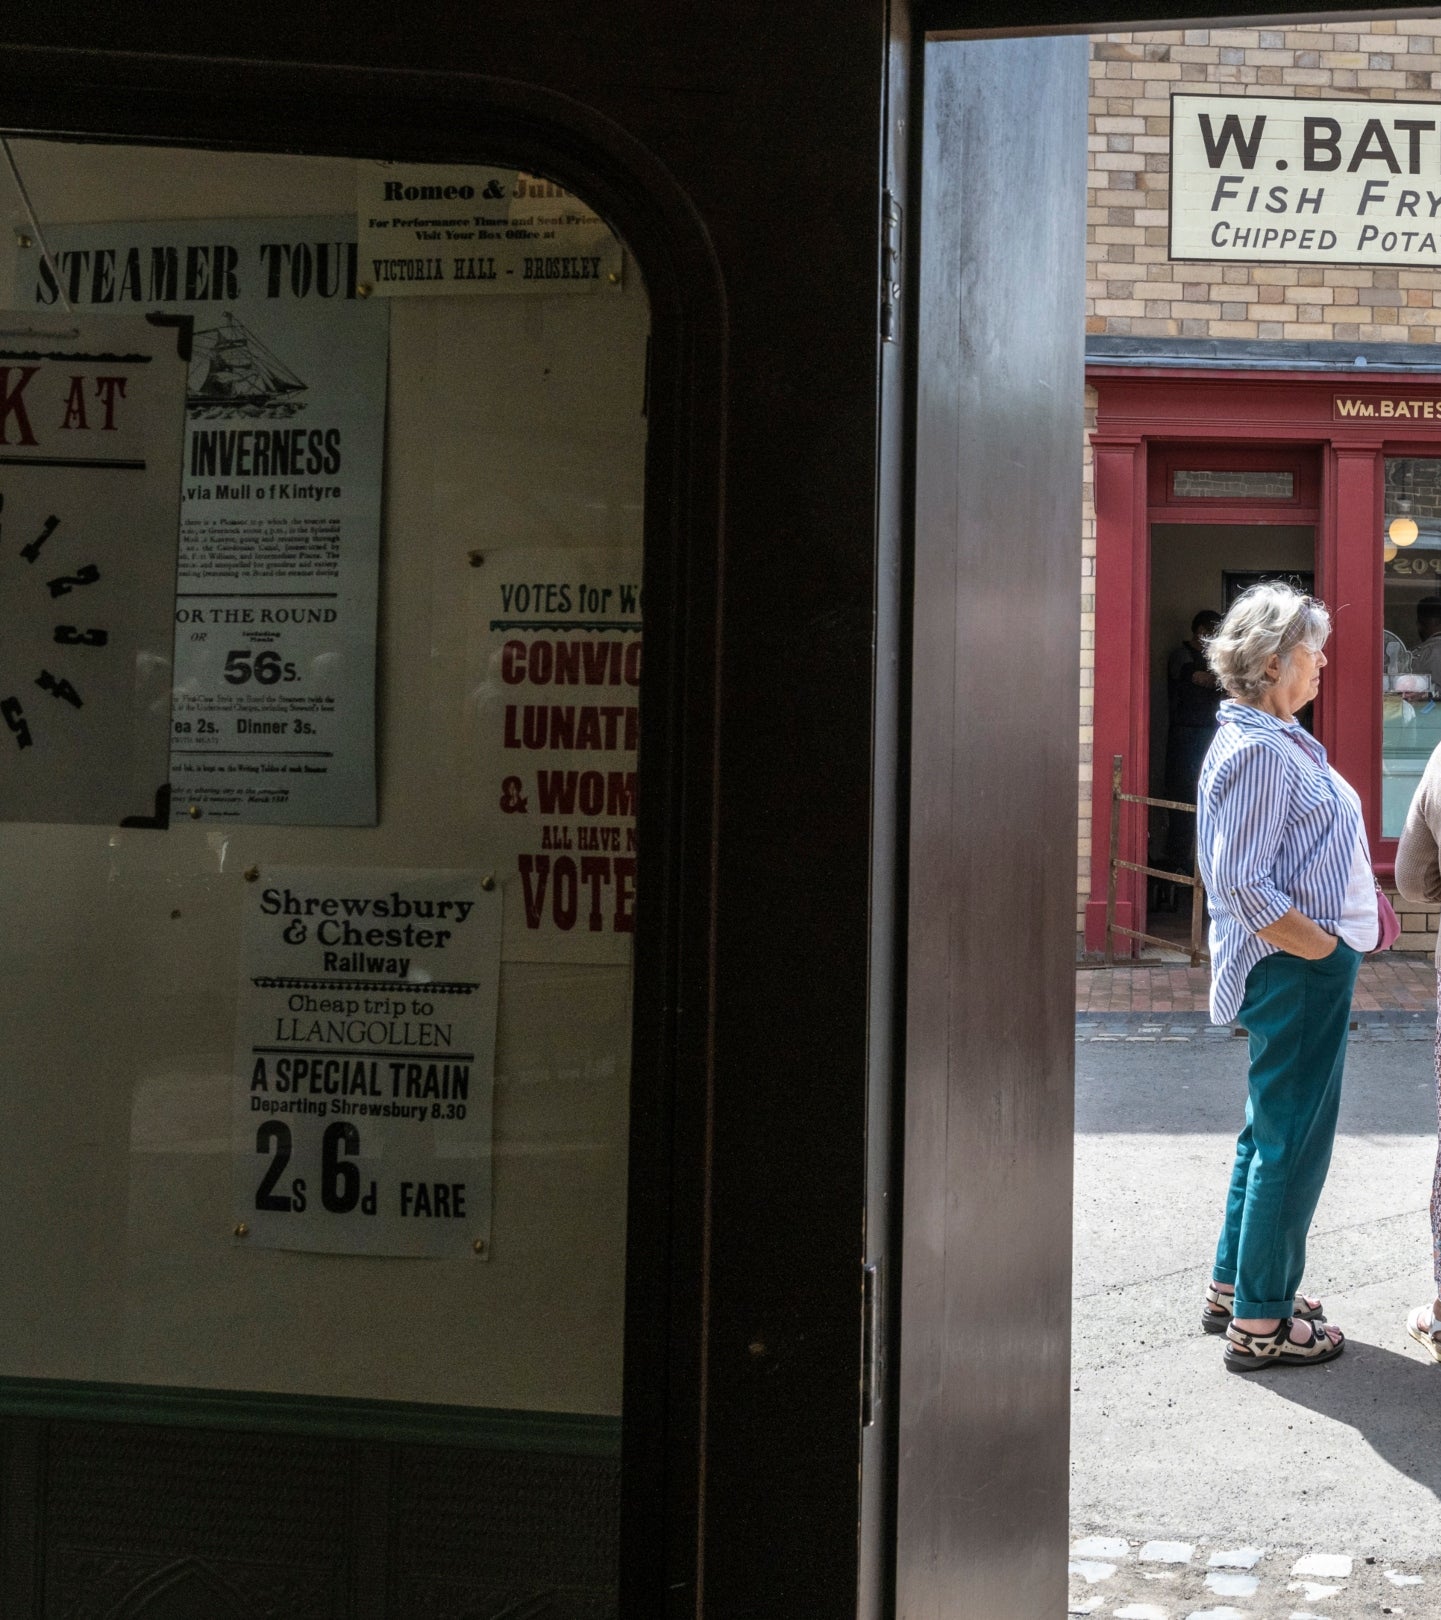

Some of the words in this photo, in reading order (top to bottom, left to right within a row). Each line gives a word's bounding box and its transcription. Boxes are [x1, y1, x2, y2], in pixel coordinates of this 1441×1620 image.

[384, 180, 475, 201] Romeo
[483, 179, 505, 200] &
[512, 178, 575, 199] Juli
[1211, 176, 1325, 215] FISH
[369, 218, 389, 229] For
[392, 217, 470, 229] Performance
[473, 217, 508, 228] Times
[415, 230, 441, 241] Visit
[446, 230, 474, 241] Your
[478, 230, 501, 241] Box
[505, 230, 538, 240] Office
[542, 230, 555, 240] at
[1212, 221, 1338, 251] CHIPPED
[36, 245, 241, 305] STEAMER
[372, 258, 444, 281] VICTORIA
[454, 257, 497, 280] HALL
[523, 256, 601, 280] BROSELEY
[60, 375, 128, 431] AT
[191, 428, 341, 477] INVERNESS
[216, 484, 250, 500] Mull
[279, 484, 341, 501] Kintyre
[501, 583, 571, 613] VOTES
[578, 584, 613, 613] for
[210, 609, 255, 623] THE
[261, 608, 337, 623] ROUND
[171, 719, 191, 734] ea
[197, 718, 220, 734] 2s.
[237, 718, 288, 734] Dinner
[293, 718, 317, 734] 3s.
[500, 776, 528, 814] &
[541, 826, 572, 850] ALL
[578, 826, 621, 850] HAVE
[260, 889, 475, 922] Shrewsbury
[283, 918, 307, 945] &
[317, 920, 451, 948] Chester
[324, 952, 411, 978] Railway
[288, 994, 360, 1017] Cheap
[364, 997, 406, 1018] trip
[412, 999, 434, 1016] to
[276, 1018, 453, 1047] LLANGOLLEN
[251, 1057, 268, 1091] A
[275, 1058, 382, 1097] SPECIAL
[389, 1063, 470, 1100] TRAIN
[251, 1096, 327, 1117] Departing
[330, 1099, 428, 1122] Shrewsbury
[431, 1103, 467, 1120] 8.30
[400, 1181, 467, 1218] FARE
